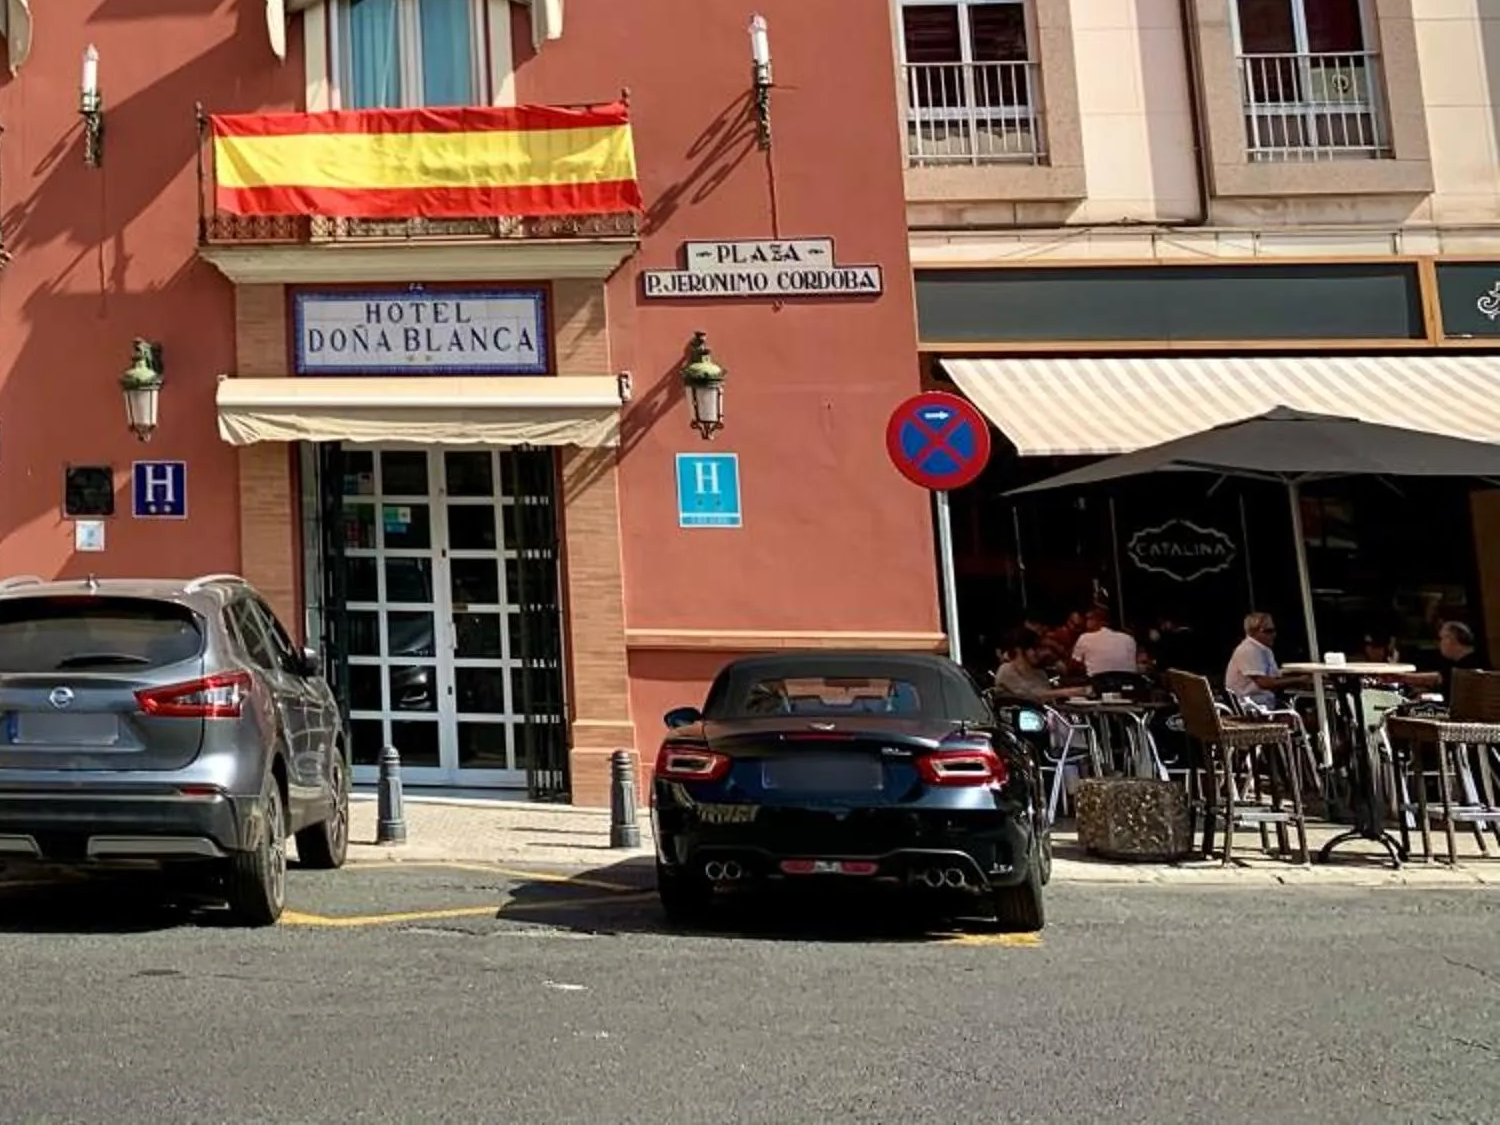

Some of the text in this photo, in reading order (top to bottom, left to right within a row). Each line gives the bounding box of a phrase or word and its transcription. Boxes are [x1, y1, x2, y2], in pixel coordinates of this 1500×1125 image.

[717, 243, 801, 264] PLAZA
[777, 270, 877, 290] CORDOBA
[365, 302, 471, 324] HOTEL
[308, 325, 535, 353] DOÑA BLANCA
[144, 464, 176, 503] H
[693, 461, 723, 495] H
[1135, 542, 1227, 557] CATALINA
